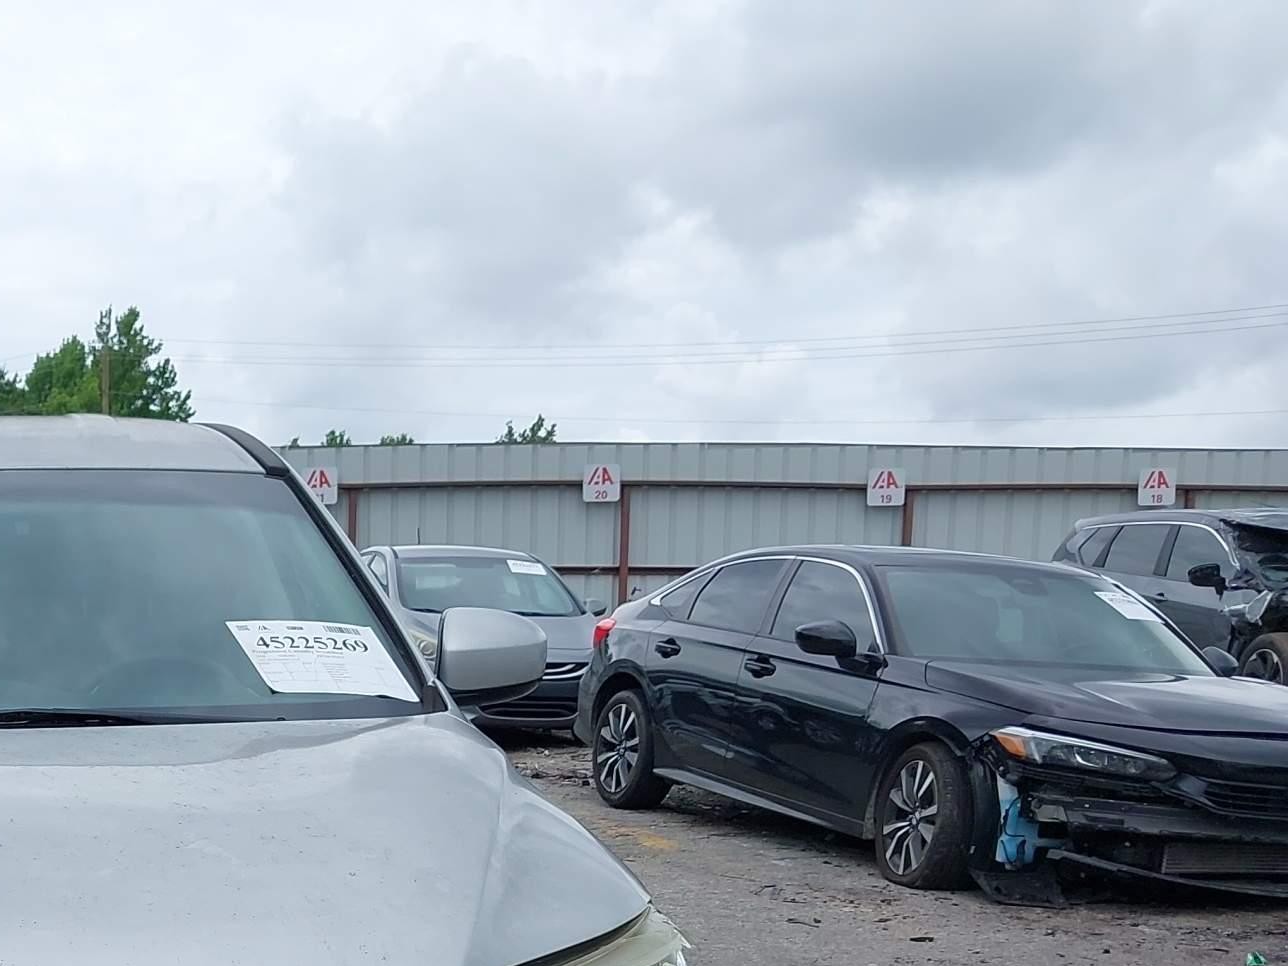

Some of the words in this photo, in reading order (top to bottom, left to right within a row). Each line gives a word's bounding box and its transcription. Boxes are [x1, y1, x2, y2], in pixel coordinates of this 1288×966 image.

[594, 490, 608, 500] 20
[880, 494, 893, 504] 19
[1151, 494, 1164, 504] 18
[256, 635, 369, 653] 45225269
